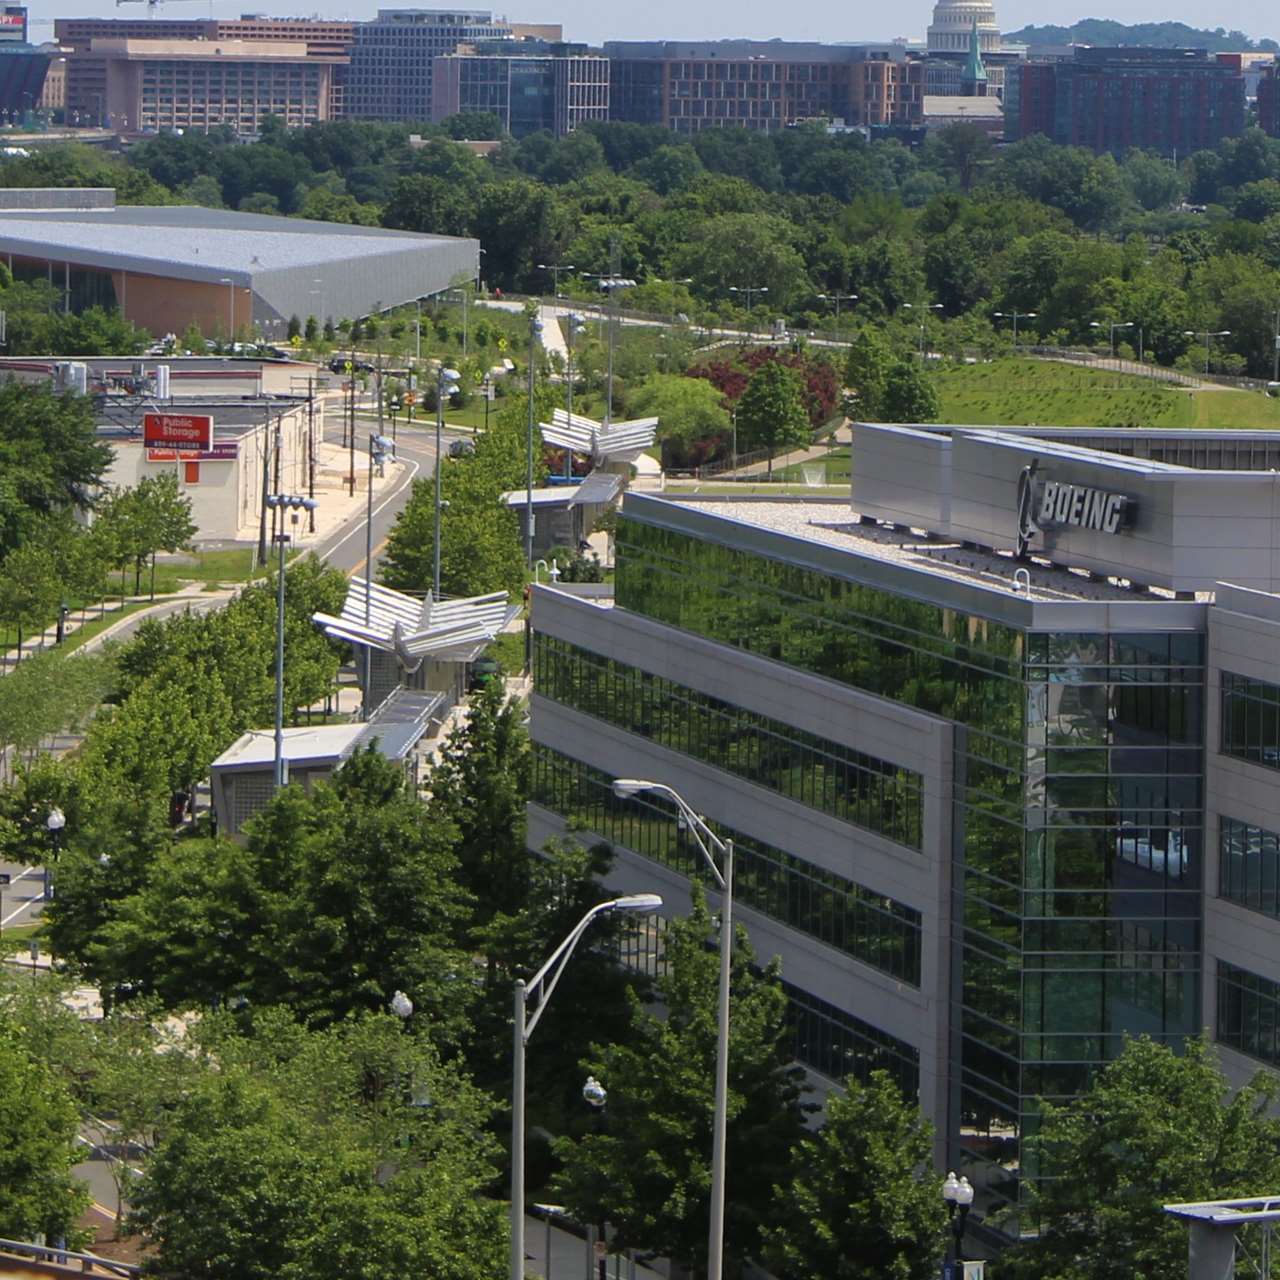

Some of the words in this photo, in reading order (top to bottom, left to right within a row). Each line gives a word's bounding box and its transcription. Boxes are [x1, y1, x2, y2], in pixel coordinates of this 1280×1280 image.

[162, 416, 193, 428] Public
[162, 426, 201, 439] Storage
[1040, 481, 1123, 535] BOEING
